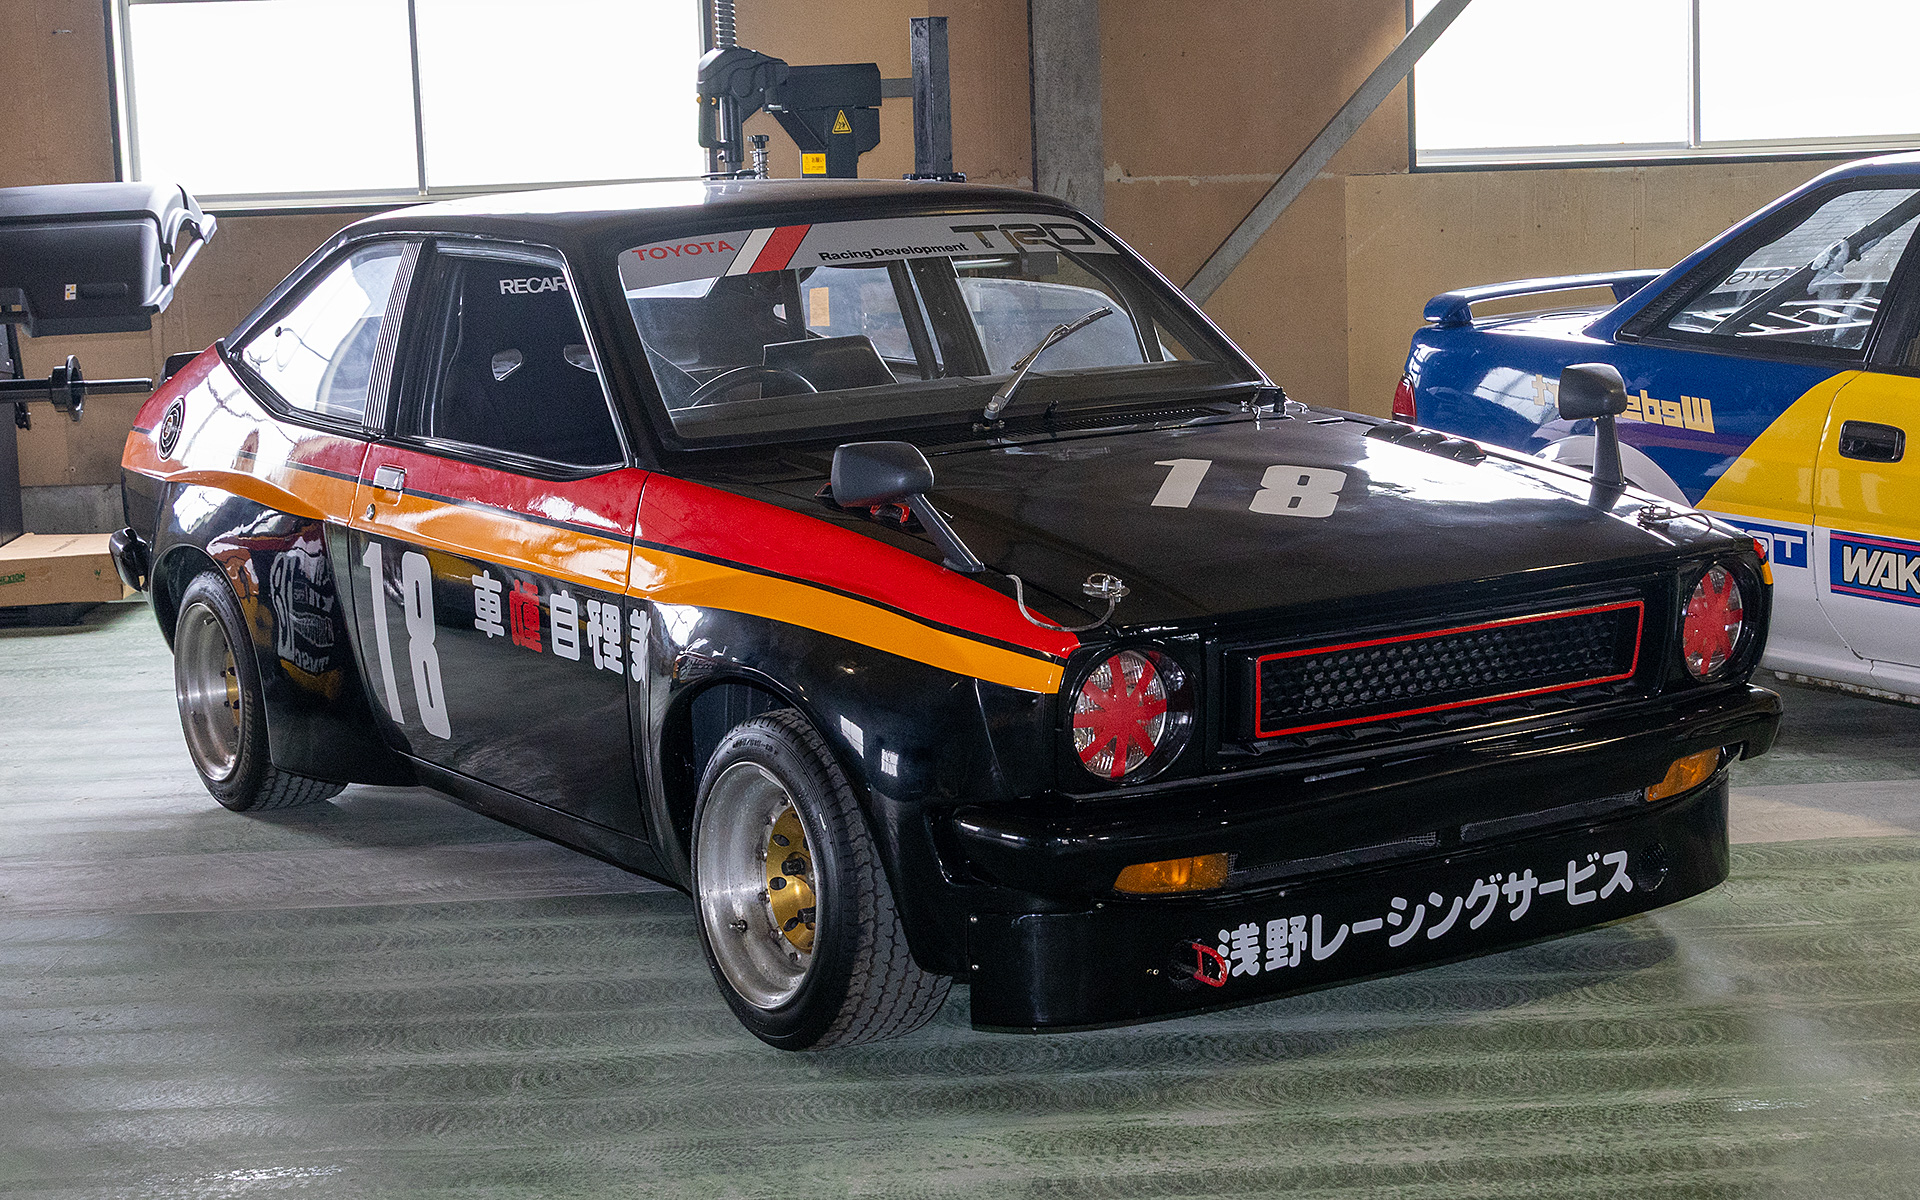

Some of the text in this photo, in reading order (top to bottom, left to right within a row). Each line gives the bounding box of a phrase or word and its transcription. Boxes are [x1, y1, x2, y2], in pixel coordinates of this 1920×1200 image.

[632, 240, 735, 261] TOYOTA
[818, 242, 969, 261] Racing Development
[950, 223, 1096, 252] TRD
[1150, 458, 1347, 518] 18
[1842, 545, 1920, 594] WAK
[362, 541, 451, 740] 18
[1217, 850, 1634, 978] 浅野レーシングサービス
